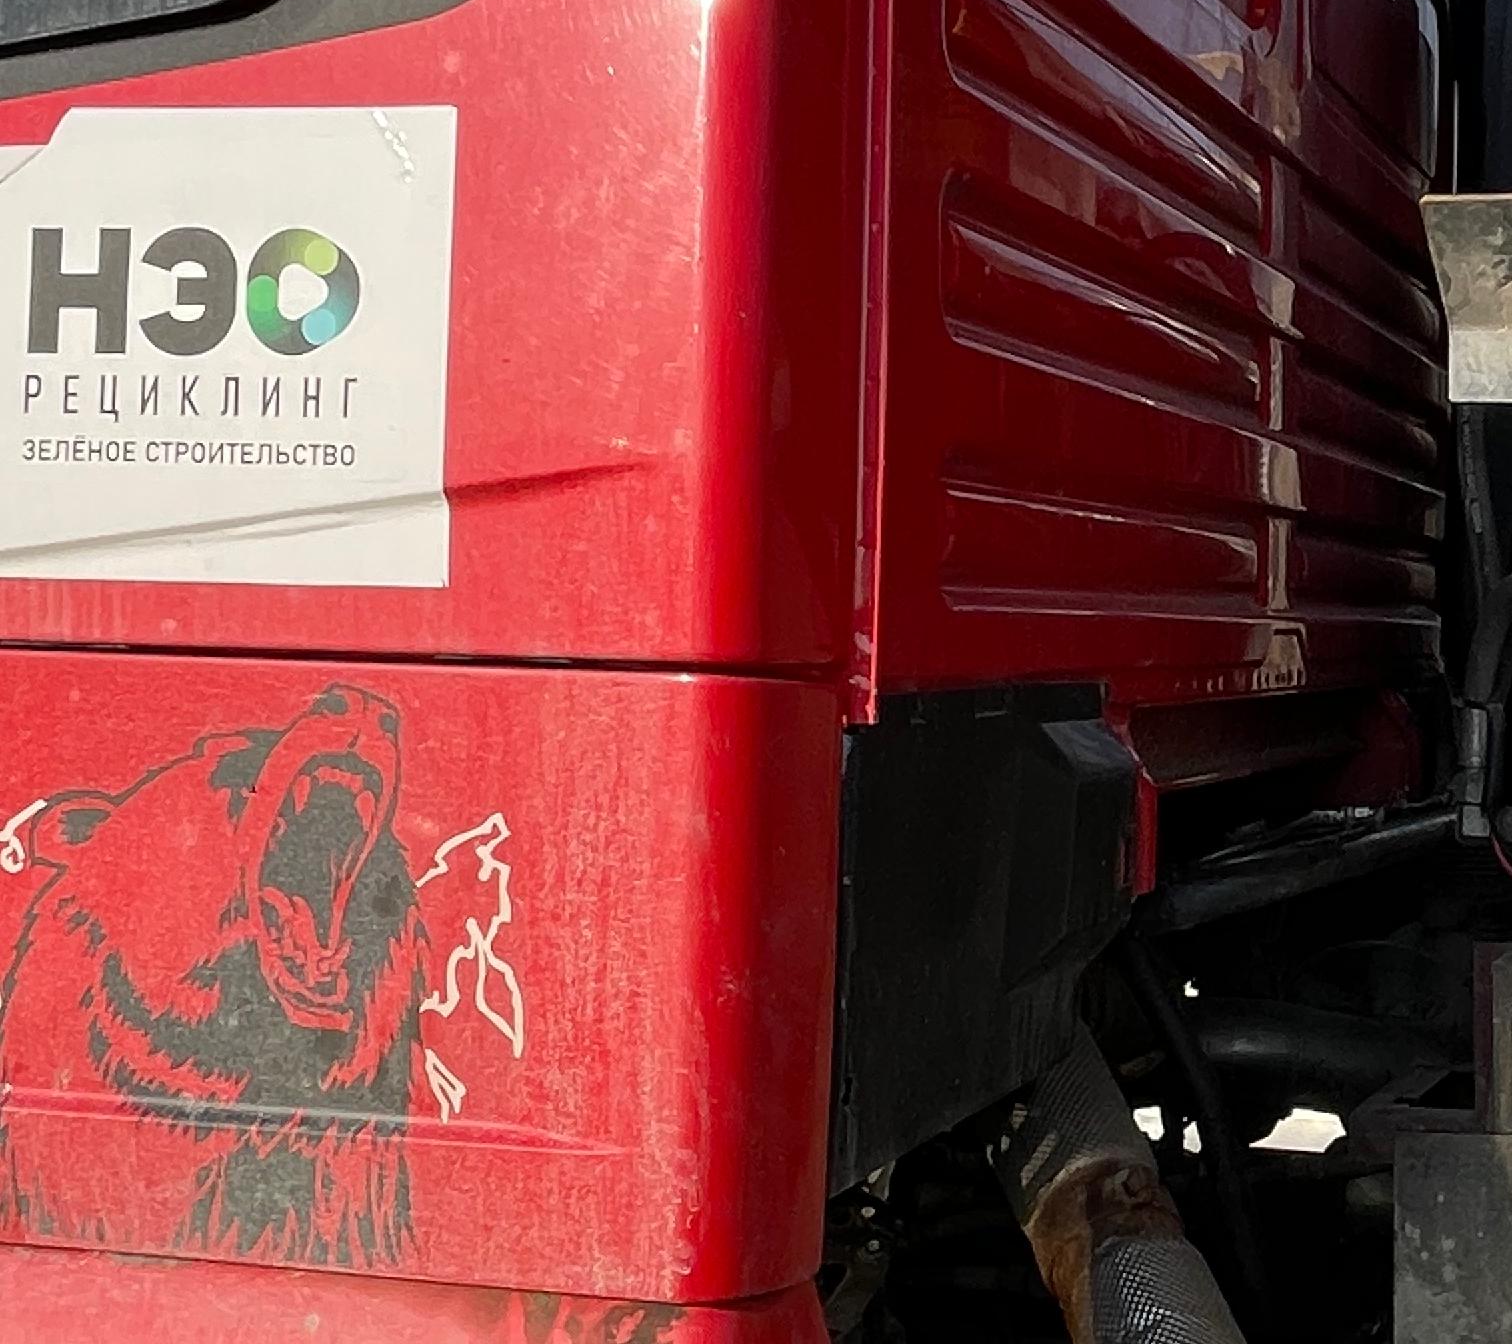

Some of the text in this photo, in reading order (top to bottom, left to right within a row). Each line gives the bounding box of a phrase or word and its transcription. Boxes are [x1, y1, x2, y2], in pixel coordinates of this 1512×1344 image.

[26, 227, 361, 356] НЭО
[23, 374, 359, 423] РЕЦИКЛИНГ
[22, 434, 356, 467] ЗЕЛЁНОЕ СТРОИТЕЛЬСТВО
